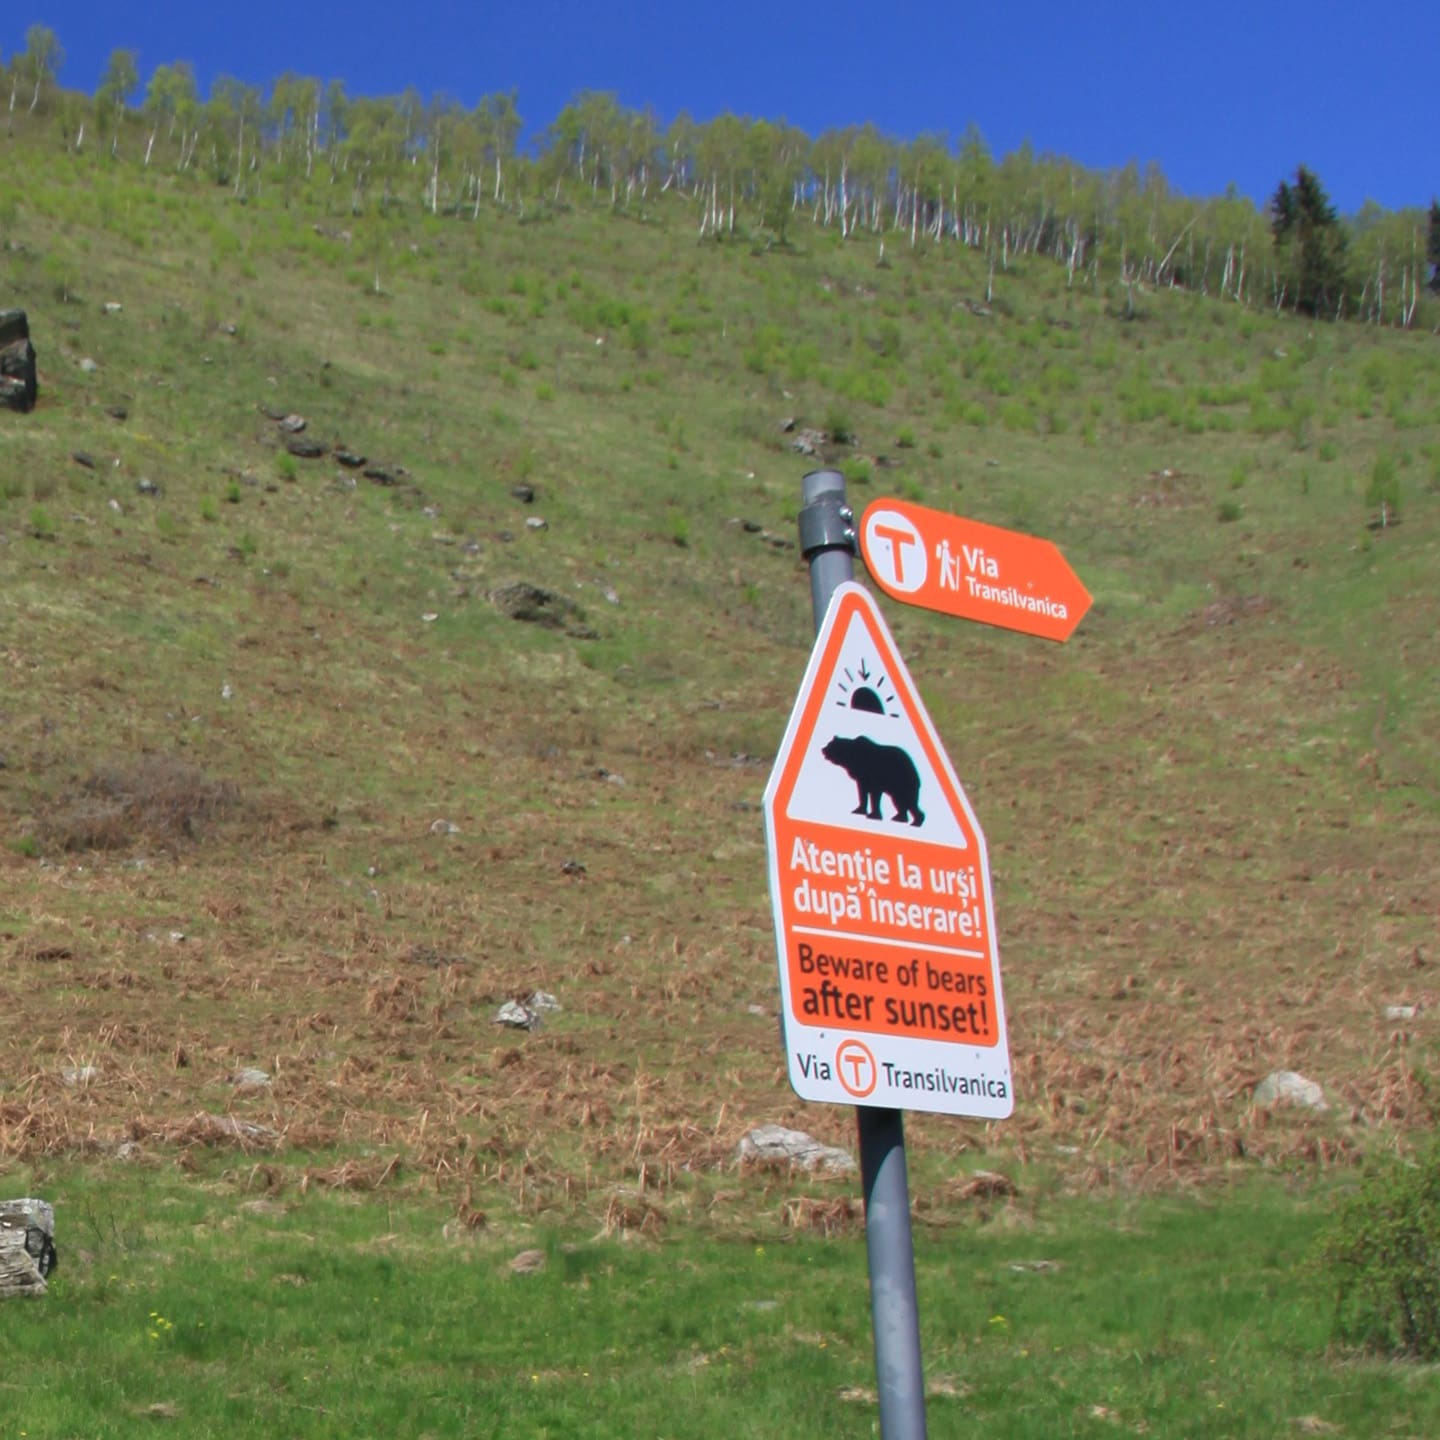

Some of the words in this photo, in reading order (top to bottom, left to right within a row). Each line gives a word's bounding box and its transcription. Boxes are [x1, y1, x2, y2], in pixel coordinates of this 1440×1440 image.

[962, 545, 999, 578] Via
[965, 575, 1067, 620] Transilvanica
[790, 836, 890, 892] Atenție
[897, 854, 922, 891] la
[930, 867, 977, 908] urși
[793, 879, 861, 925] după
[869, 887, 982, 938] înserare!
[798, 943, 888, 984] Beware
[896, 960, 919, 987] of
[926, 961, 987, 996] bears
[803, 980, 874, 1022] after
[885, 997, 990, 1036] sunset!
[797, 1052, 831, 1081] Via
[882, 1061, 1008, 1099] Transilvanica
